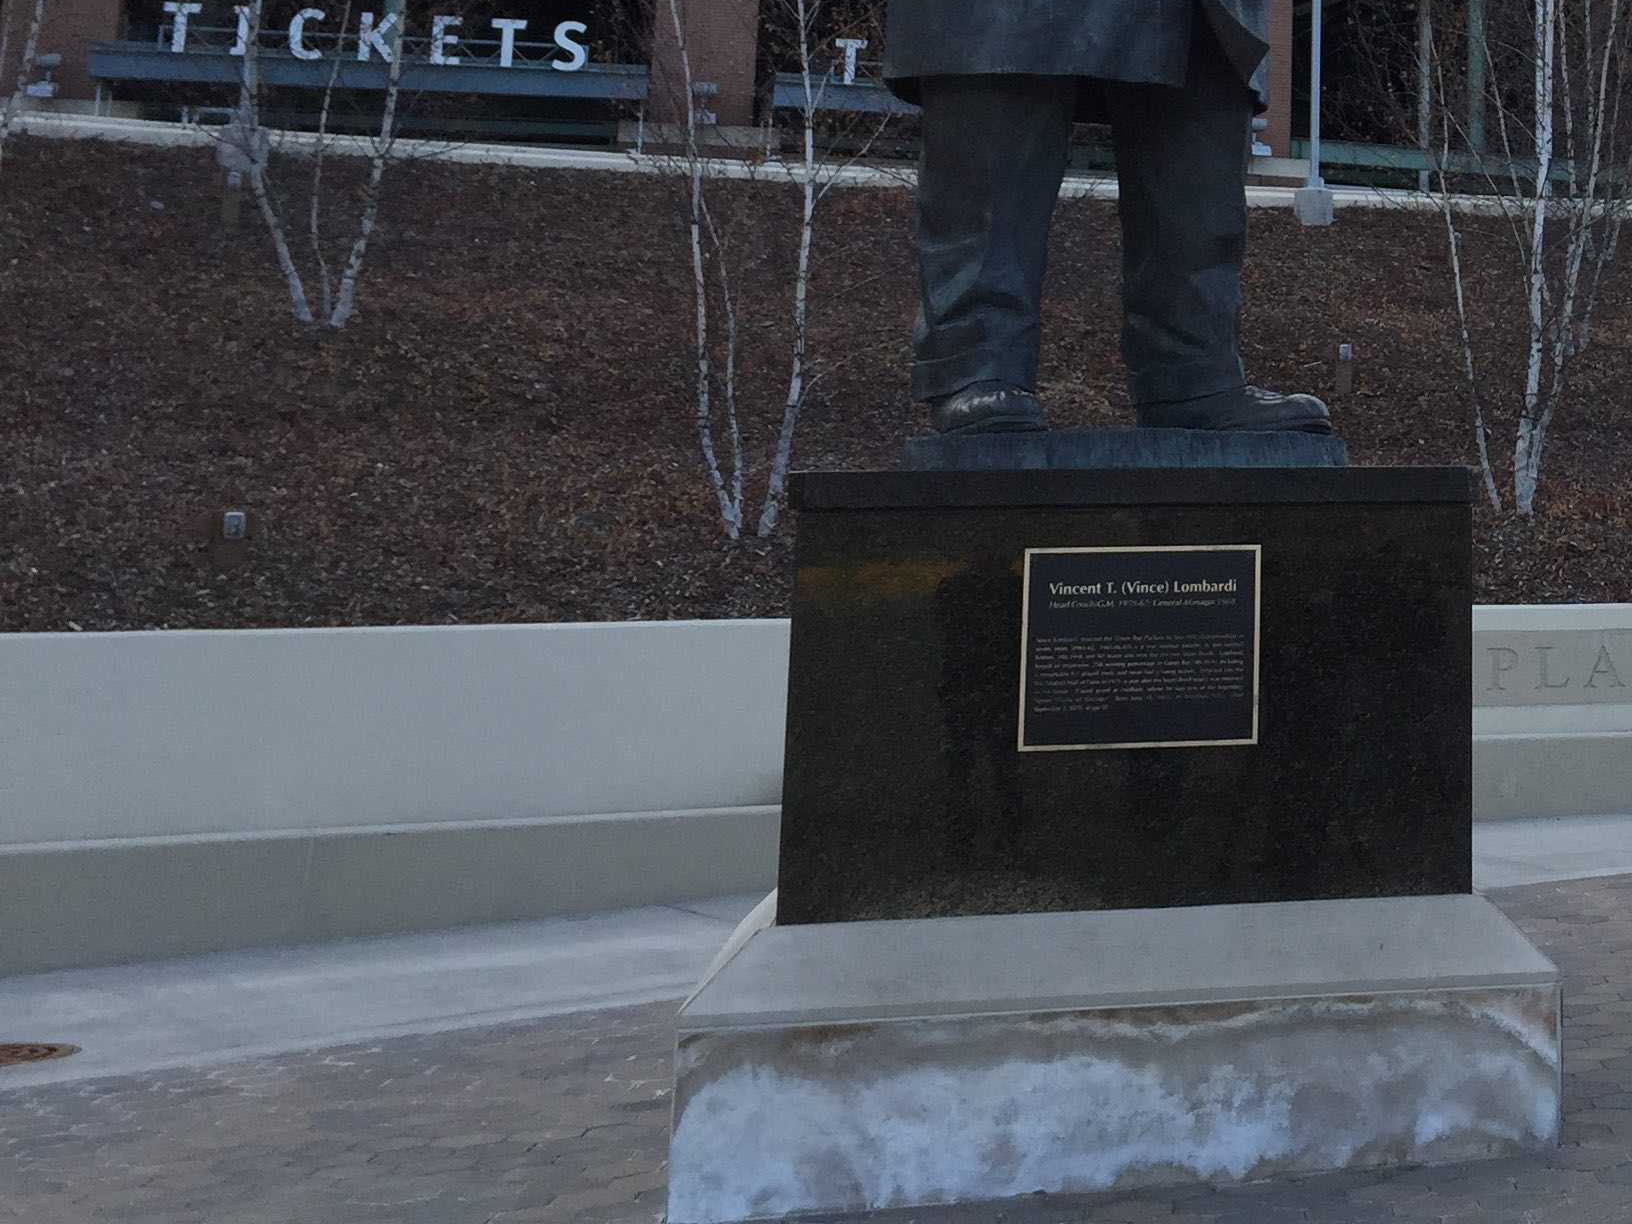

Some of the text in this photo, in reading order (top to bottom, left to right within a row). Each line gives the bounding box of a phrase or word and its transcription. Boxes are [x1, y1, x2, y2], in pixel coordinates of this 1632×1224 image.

[163, 1, 588, 72] TICKETS
[1050, 579, 1237, 595] Vincent T. (Vince) Lombardi
